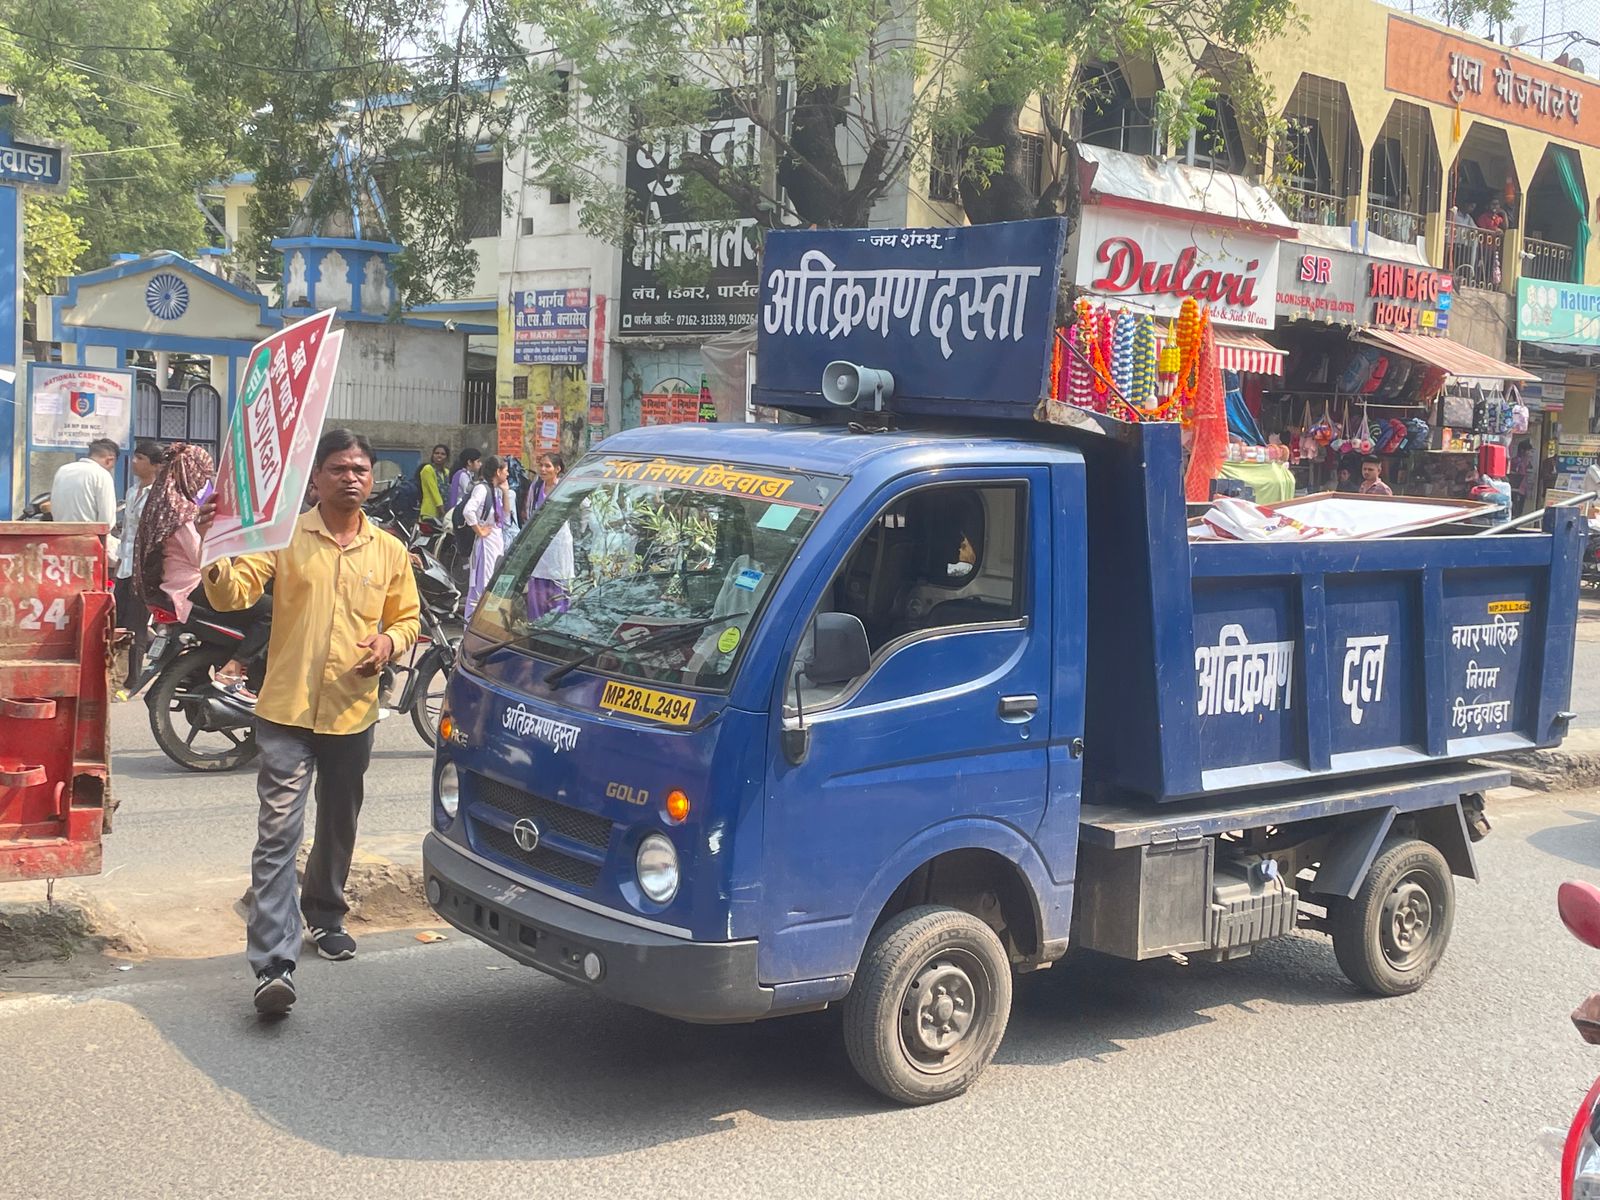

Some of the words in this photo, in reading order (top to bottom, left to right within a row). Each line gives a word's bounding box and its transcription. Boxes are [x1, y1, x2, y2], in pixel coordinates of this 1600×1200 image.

[1450, 52, 1484, 103] गुप्ता
[0, 146, 54, 181] वाड़ा
[870, 235, 898, 248] जय
[1092, 237, 1259, 308] Dulari
[1301, 255, 1332, 284] SR
[1371, 262, 1405, 301] JAIN
[1406, 267, 1439, 305] BAG
[763, 250, 937, 341] अतिक्रमण
[929, 266, 1041, 360] दस्ता
[1276, 292, 1311, 309] OLONISER
[1375, 302, 1418, 332] HOUSE
[253, 387, 280, 490] Citykart
[639, 457, 699, 484] निगम
[1194, 623, 1295, 717] अतिक्रमण
[1342, 634, 1389, 725] दल
[1466, 660, 1500, 689] निगम
[603, 684, 691, 721] MP.28.L.2494
[606, 781, 649, 805] GOLD
